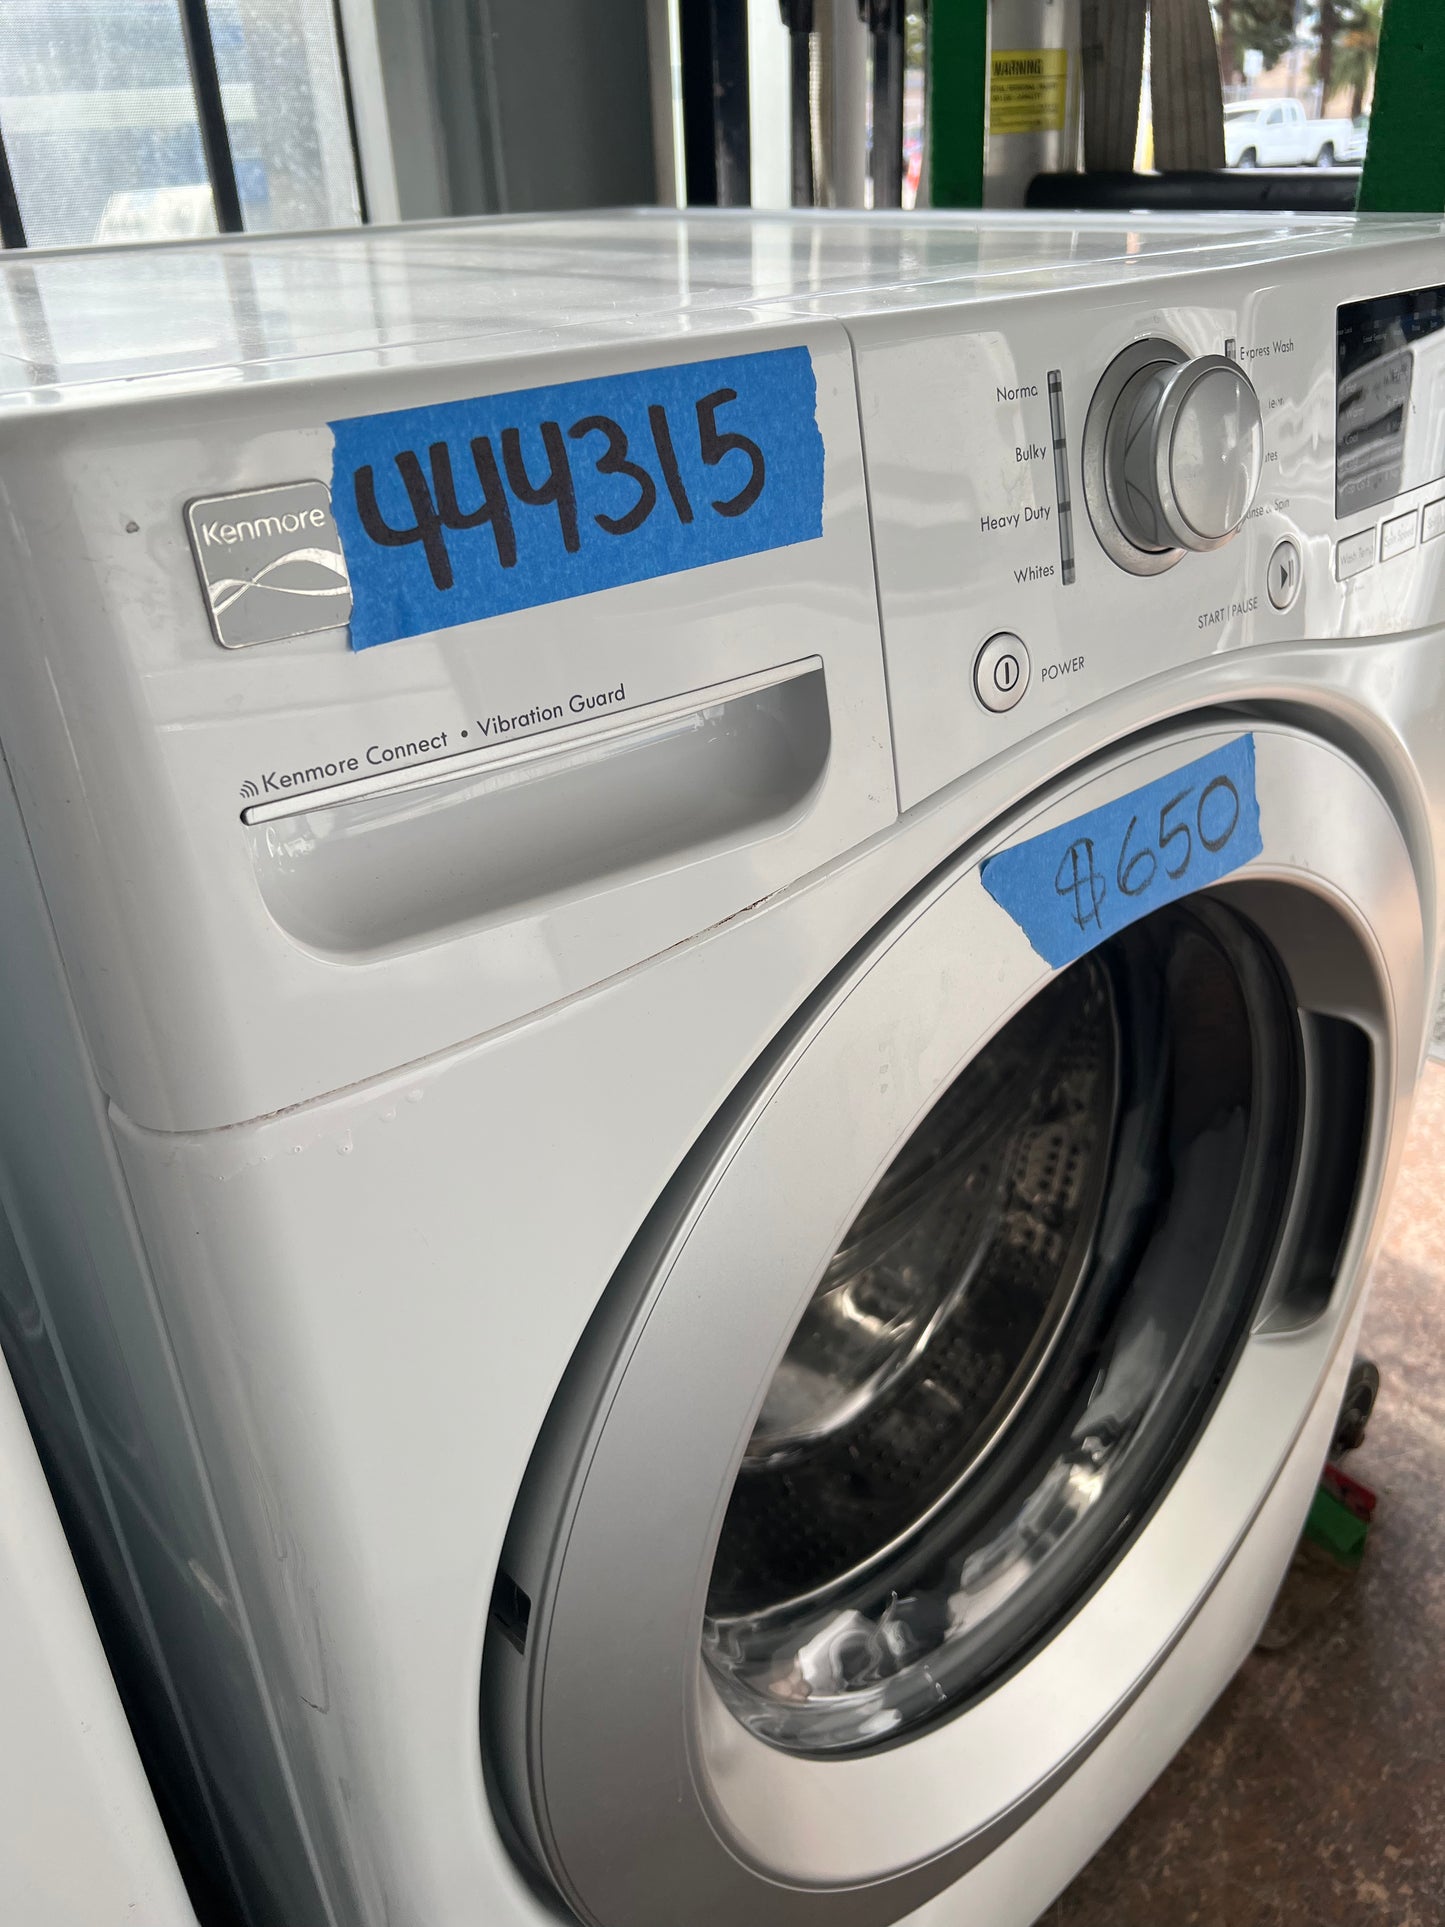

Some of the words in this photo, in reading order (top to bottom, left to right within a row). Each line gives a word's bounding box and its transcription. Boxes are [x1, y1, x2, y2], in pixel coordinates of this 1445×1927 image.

[1272, 337, 1294, 353] Wash
[996, 385, 1038, 402] Norma
[1015, 444, 1047, 462] Bulky
[353, 387, 765, 591] 444315
[980, 513, 1020, 532] Heavy
[1024, 506, 1051, 522] Duty
[1246, 505, 1264, 520] inse
[1274, 498, 1290, 512] Spin
[202, 508, 326, 546] Kenmore
[1013, 564, 1055, 584] Whites
[1197, 608, 1225, 629] START
[1231, 597, 1259, 620] PAUSE
[1041, 656, 1085, 682] POWER
[261, 755, 359, 793] Kenmore
[366, 731, 449, 766] Connect
[477, 703, 564, 737] Vibration
[569, 683, 627, 713] Guard
[1055, 775, 1239, 931] $650
